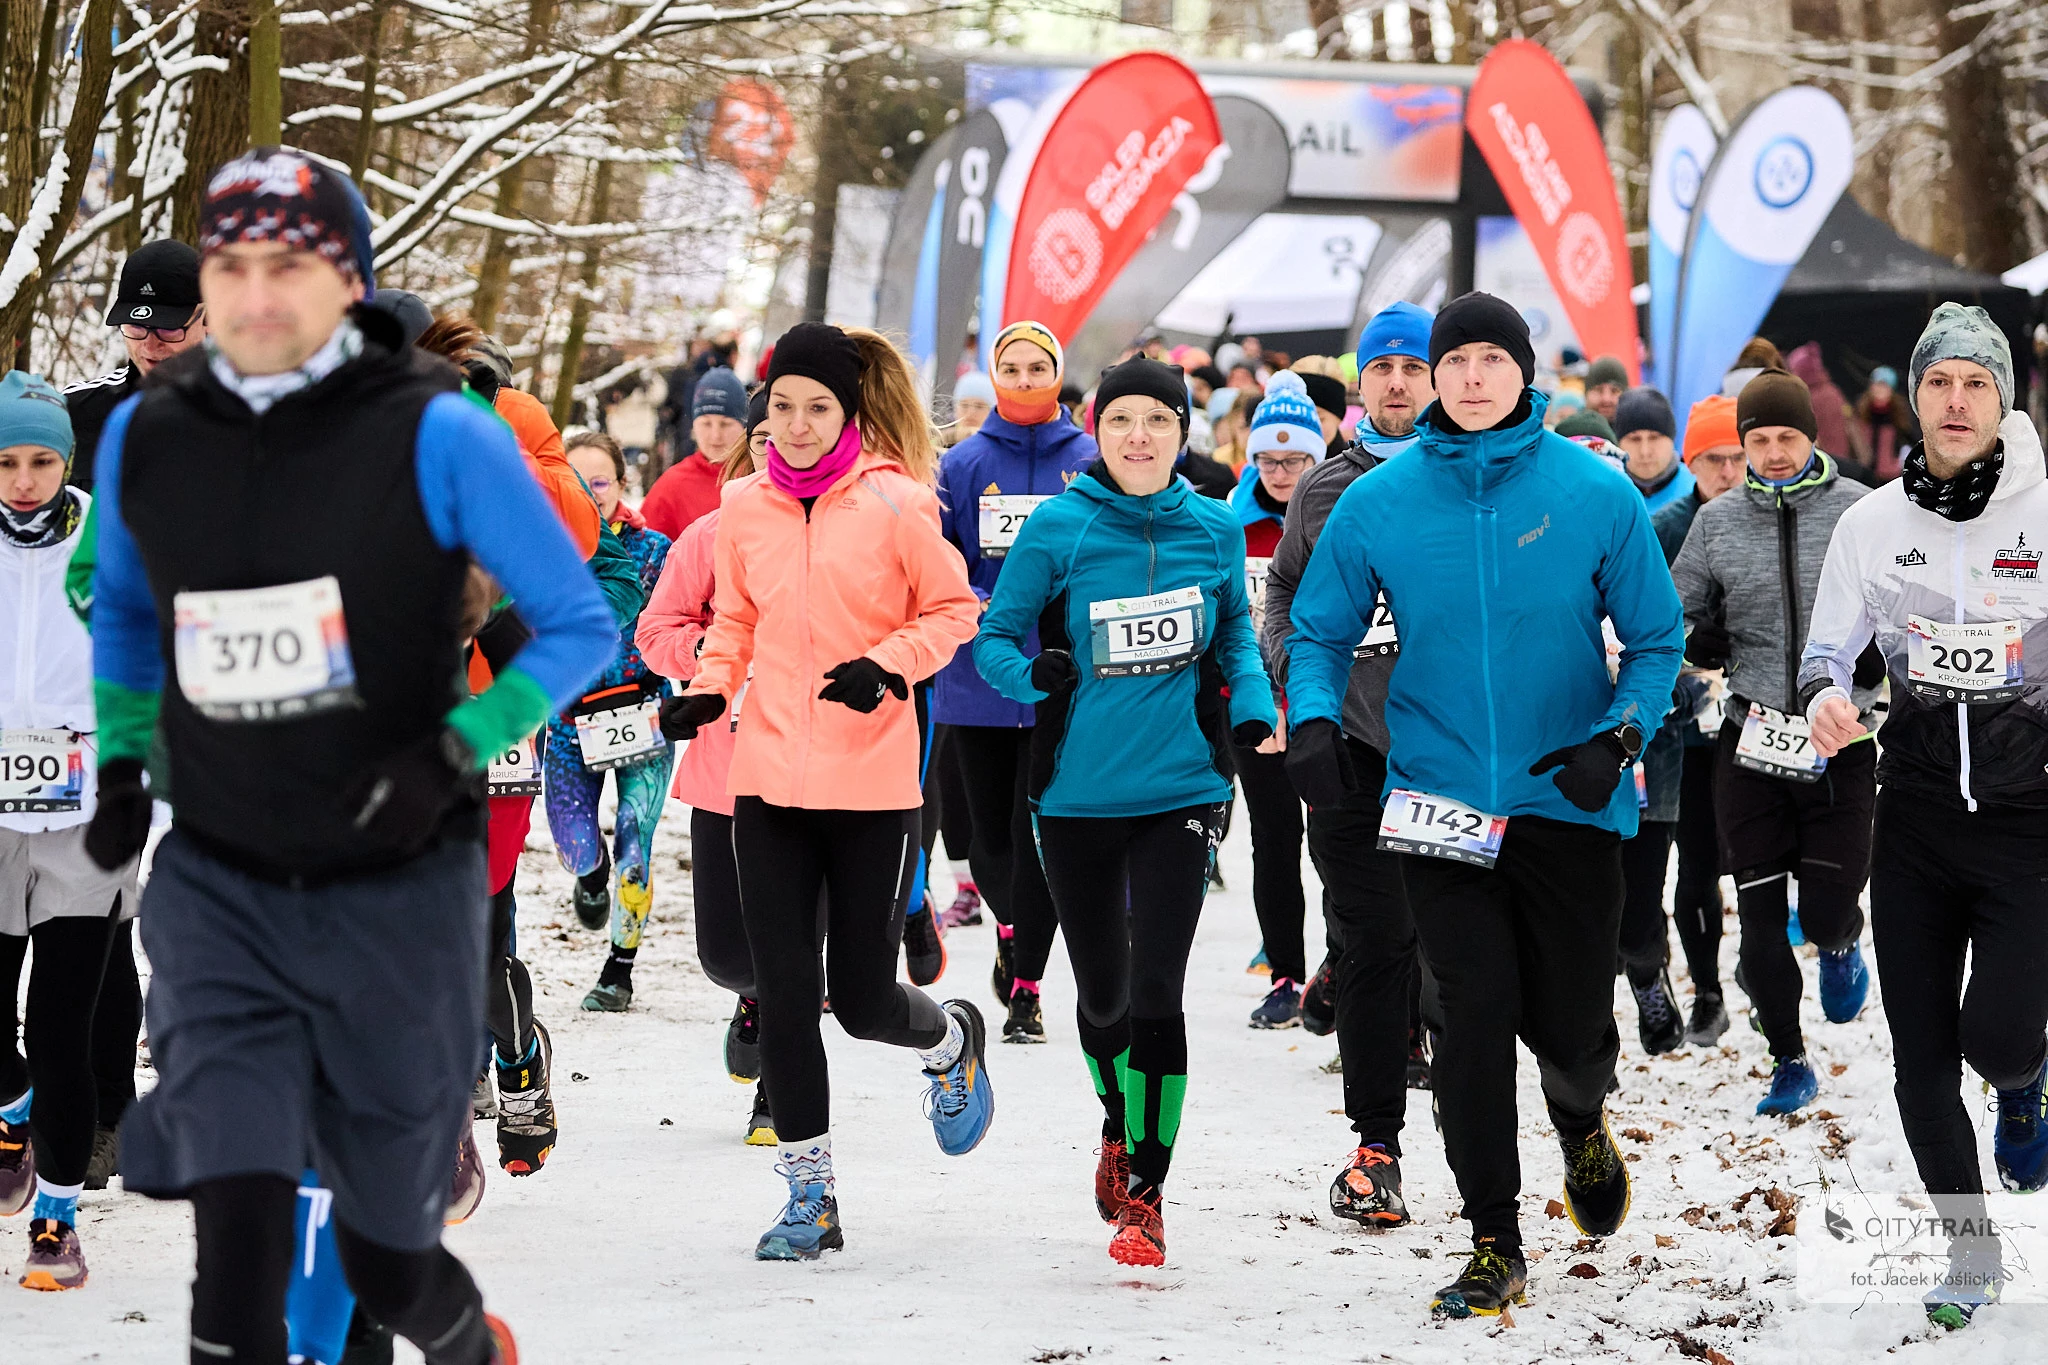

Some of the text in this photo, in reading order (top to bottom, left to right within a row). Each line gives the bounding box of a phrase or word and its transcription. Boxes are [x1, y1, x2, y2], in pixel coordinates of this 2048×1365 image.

[1085, 129, 1146, 210] SKLEP
[1100, 115, 1195, 231] BIEGACZA
[1386, 338, 1404, 349] 4F
[1995, 549, 2043, 561] OLEJ
[1991, 567, 2038, 579] TEAM
[1120, 617, 1178, 647] 150
[213, 629, 302, 674] 370
[1133, 648, 1170, 660] MAGDA
[1930, 645, 1995, 674] 202
[1938, 673, 1990, 687] KRZYSZTOF
[605, 724, 636, 746] 26
[1761, 726, 1809, 755] 357
[0, 754, 60, 781] 190
[489, 771, 519, 779] ARIUSZ
[1411, 801, 1483, 838] 1142
